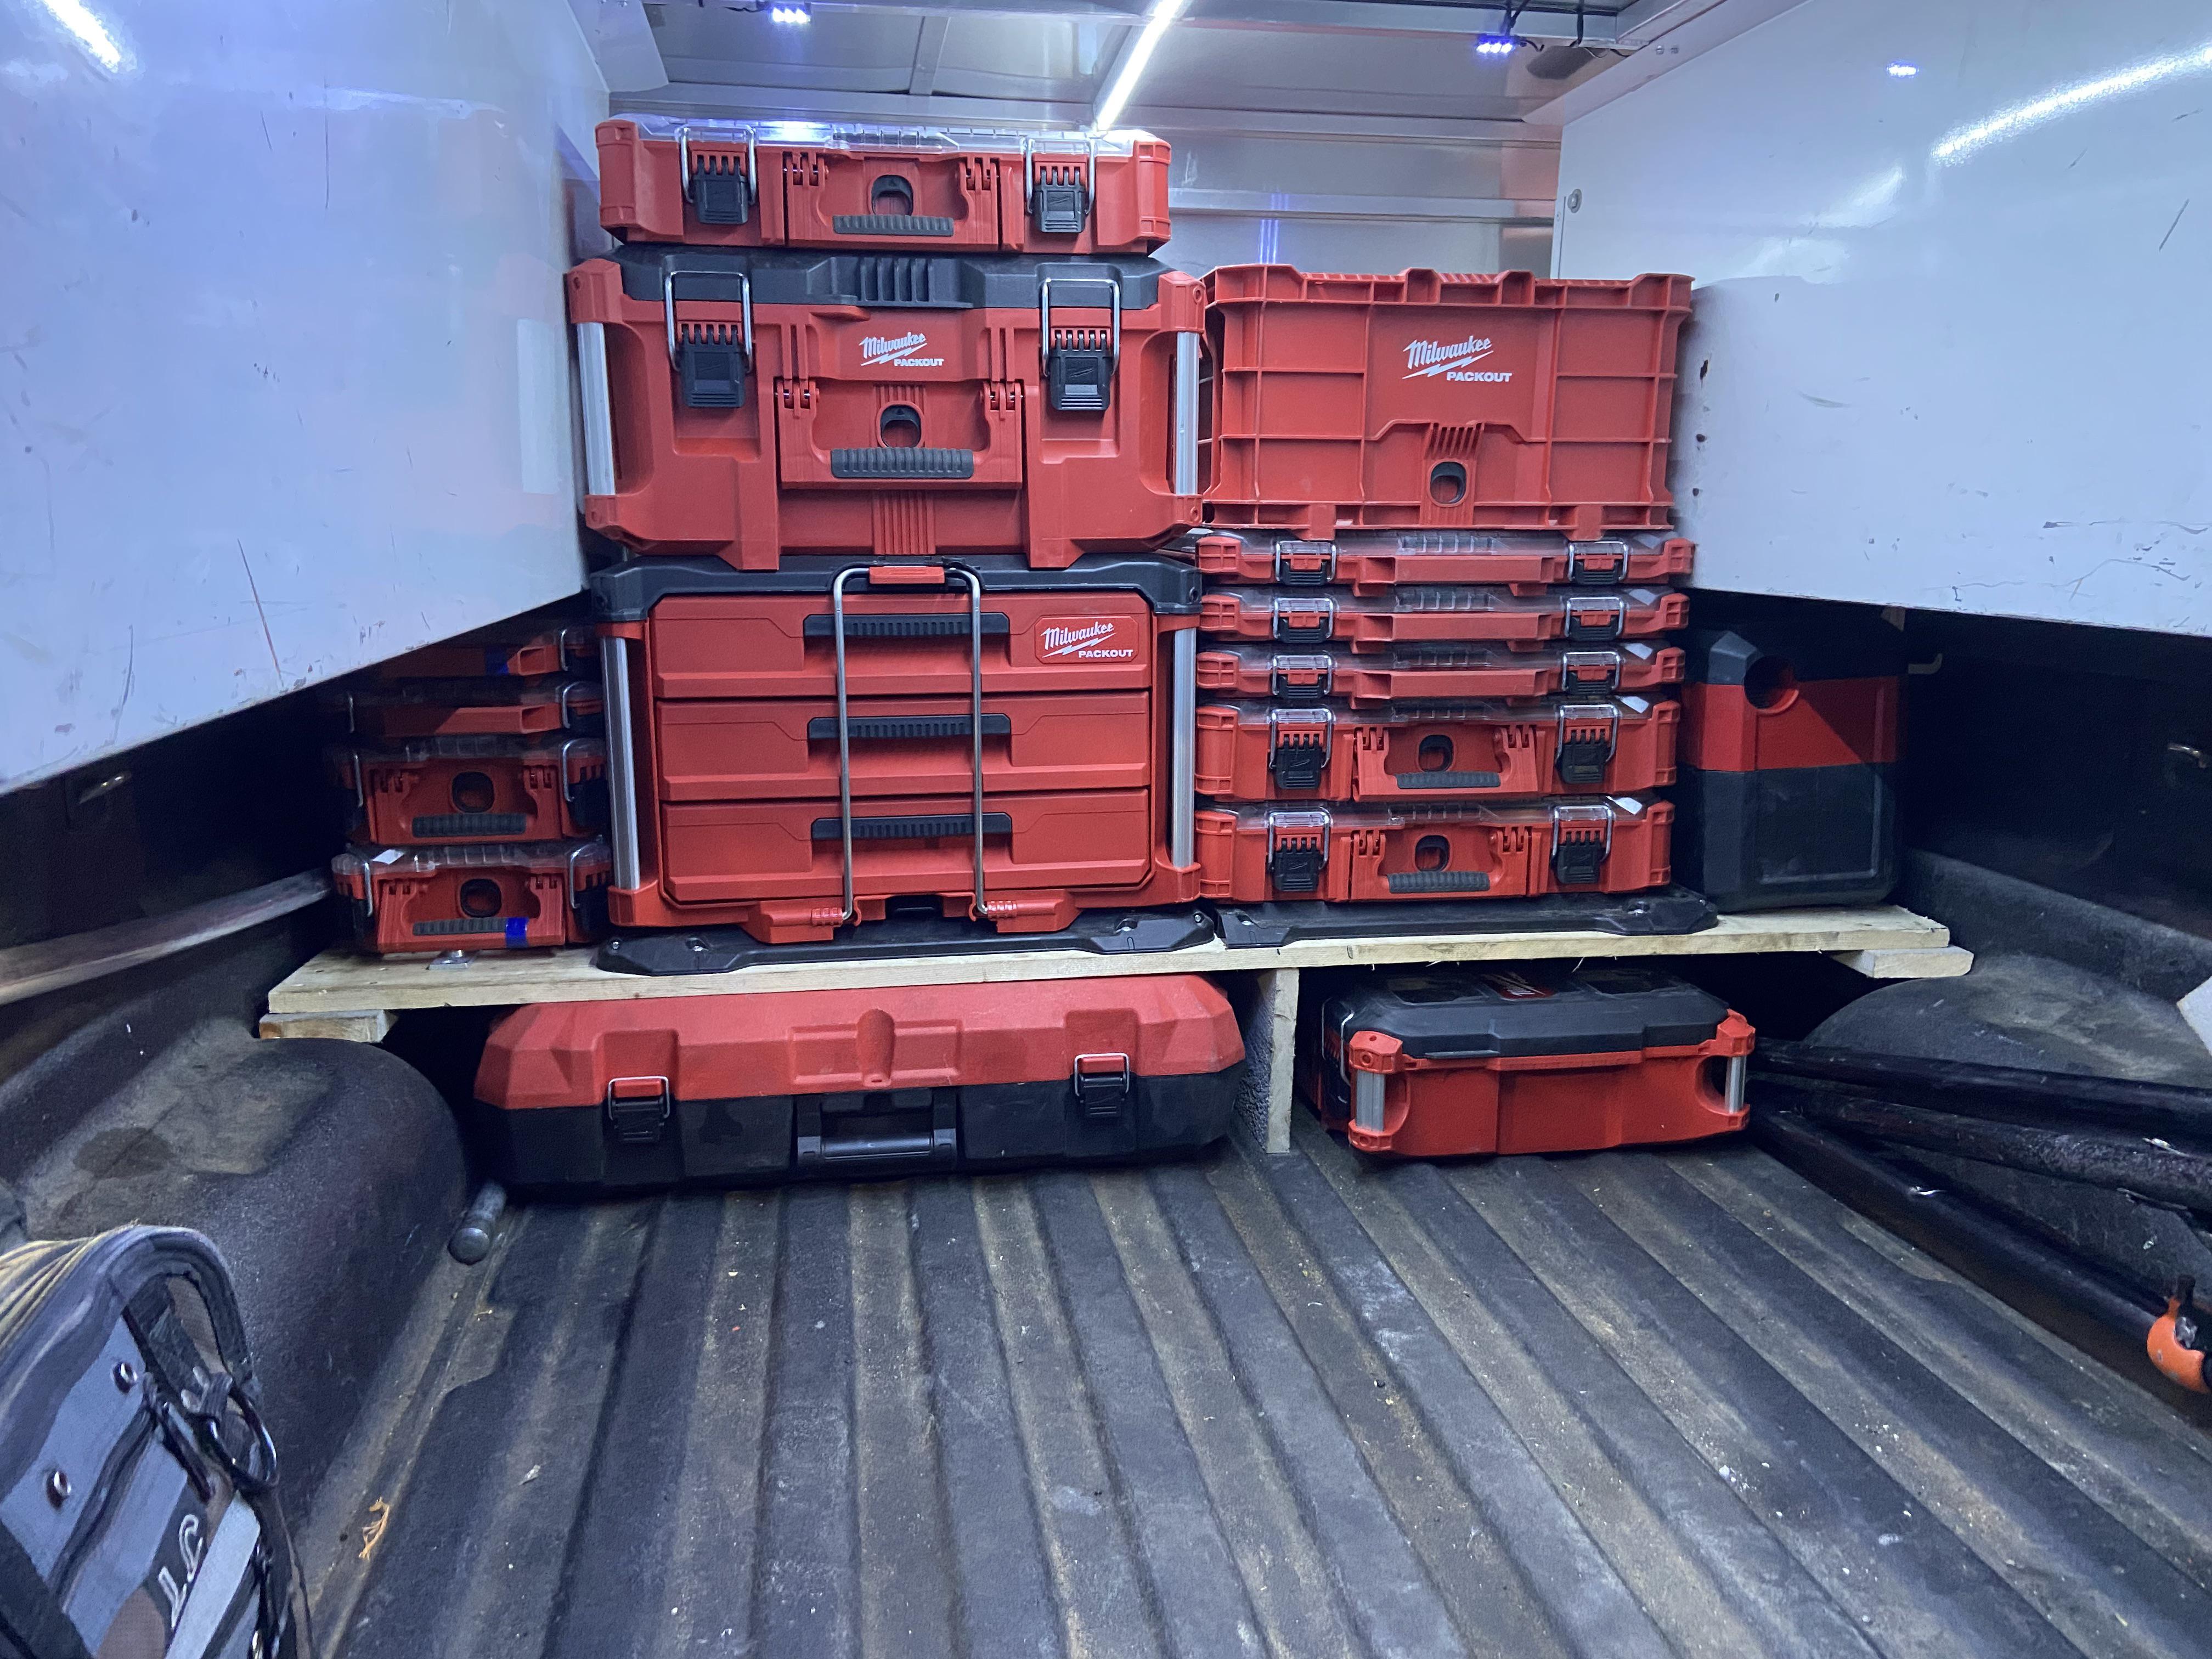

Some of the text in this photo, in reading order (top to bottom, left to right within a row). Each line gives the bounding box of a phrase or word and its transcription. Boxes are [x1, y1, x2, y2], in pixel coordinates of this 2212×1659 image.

[859, 331, 926, 359] Milwaukee
[1403, 335, 1492, 369] Milwaukee
[895, 358, 944, 366] PACKOUT
[1447, 371, 1513, 382] PACKOUT
[1040, 621, 1114, 650] Milwaukee
[1079, 649, 1133, 658] PACKOUT
